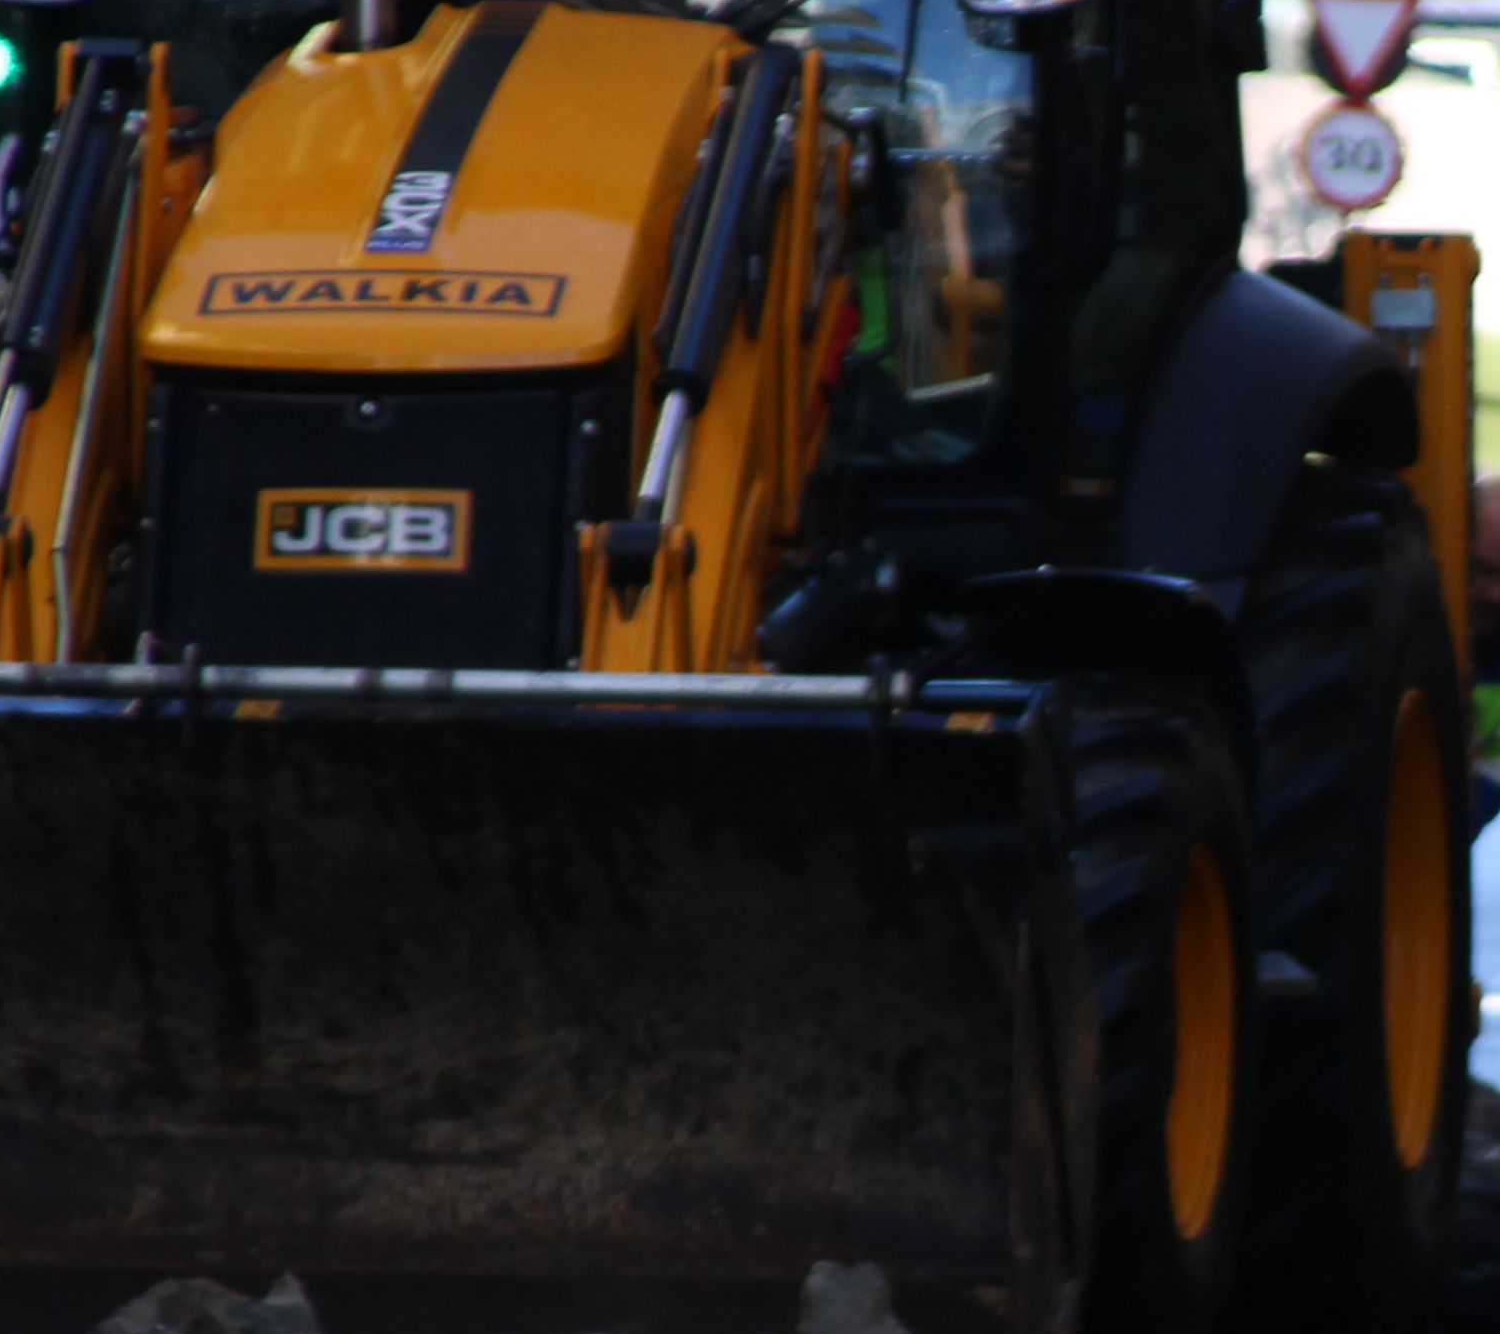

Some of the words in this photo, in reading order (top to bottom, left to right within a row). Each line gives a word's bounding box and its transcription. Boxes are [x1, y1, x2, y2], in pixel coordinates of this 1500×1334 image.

[1317, 133, 1384, 175] 30
[231, 278, 533, 306] WALKIA
[272, 504, 449, 553] JCB
